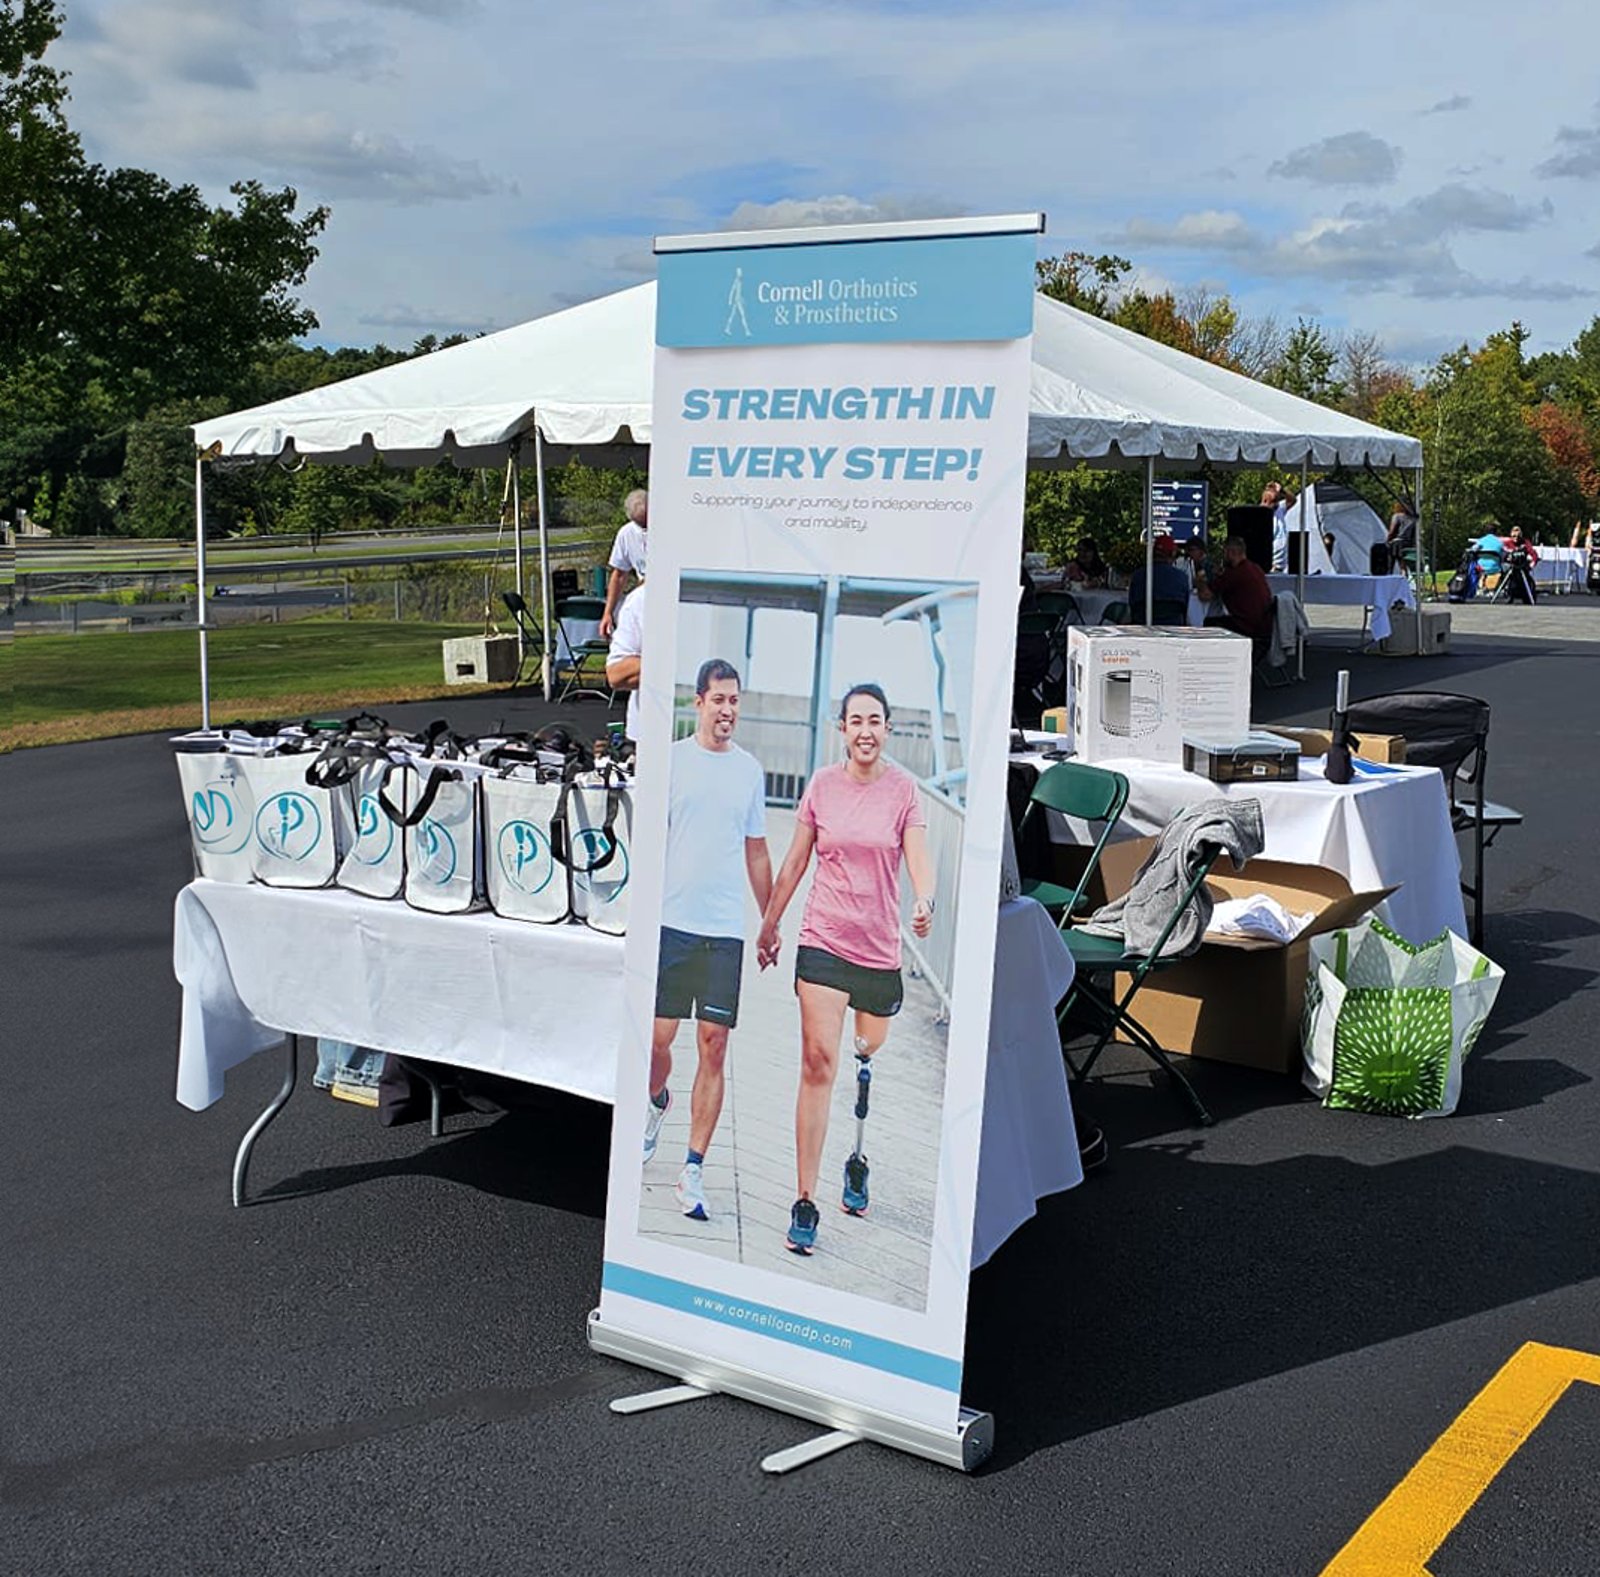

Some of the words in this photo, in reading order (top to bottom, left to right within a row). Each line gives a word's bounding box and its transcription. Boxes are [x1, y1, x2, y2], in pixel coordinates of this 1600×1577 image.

[757, 279, 823, 304] Cornell
[828, 277, 918, 301] Orthotics
[774, 307, 789, 326] &
[794, 301, 898, 325] Prosthetics
[681, 386, 934, 421] STRENGTH
[939, 386, 996, 420] IN
[687, 446, 838, 478] EVERY
[842, 447, 983, 482] STEP!
[691, 492, 763, 509] Supporting
[764, 498, 797, 510] your
[797, 498, 849, 511] journey
[852, 499, 869, 509] to
[871, 499, 973, 512] independence
[784, 516, 811, 528] and
[693, 1296, 852, 1349] www.cornelloandp.com
